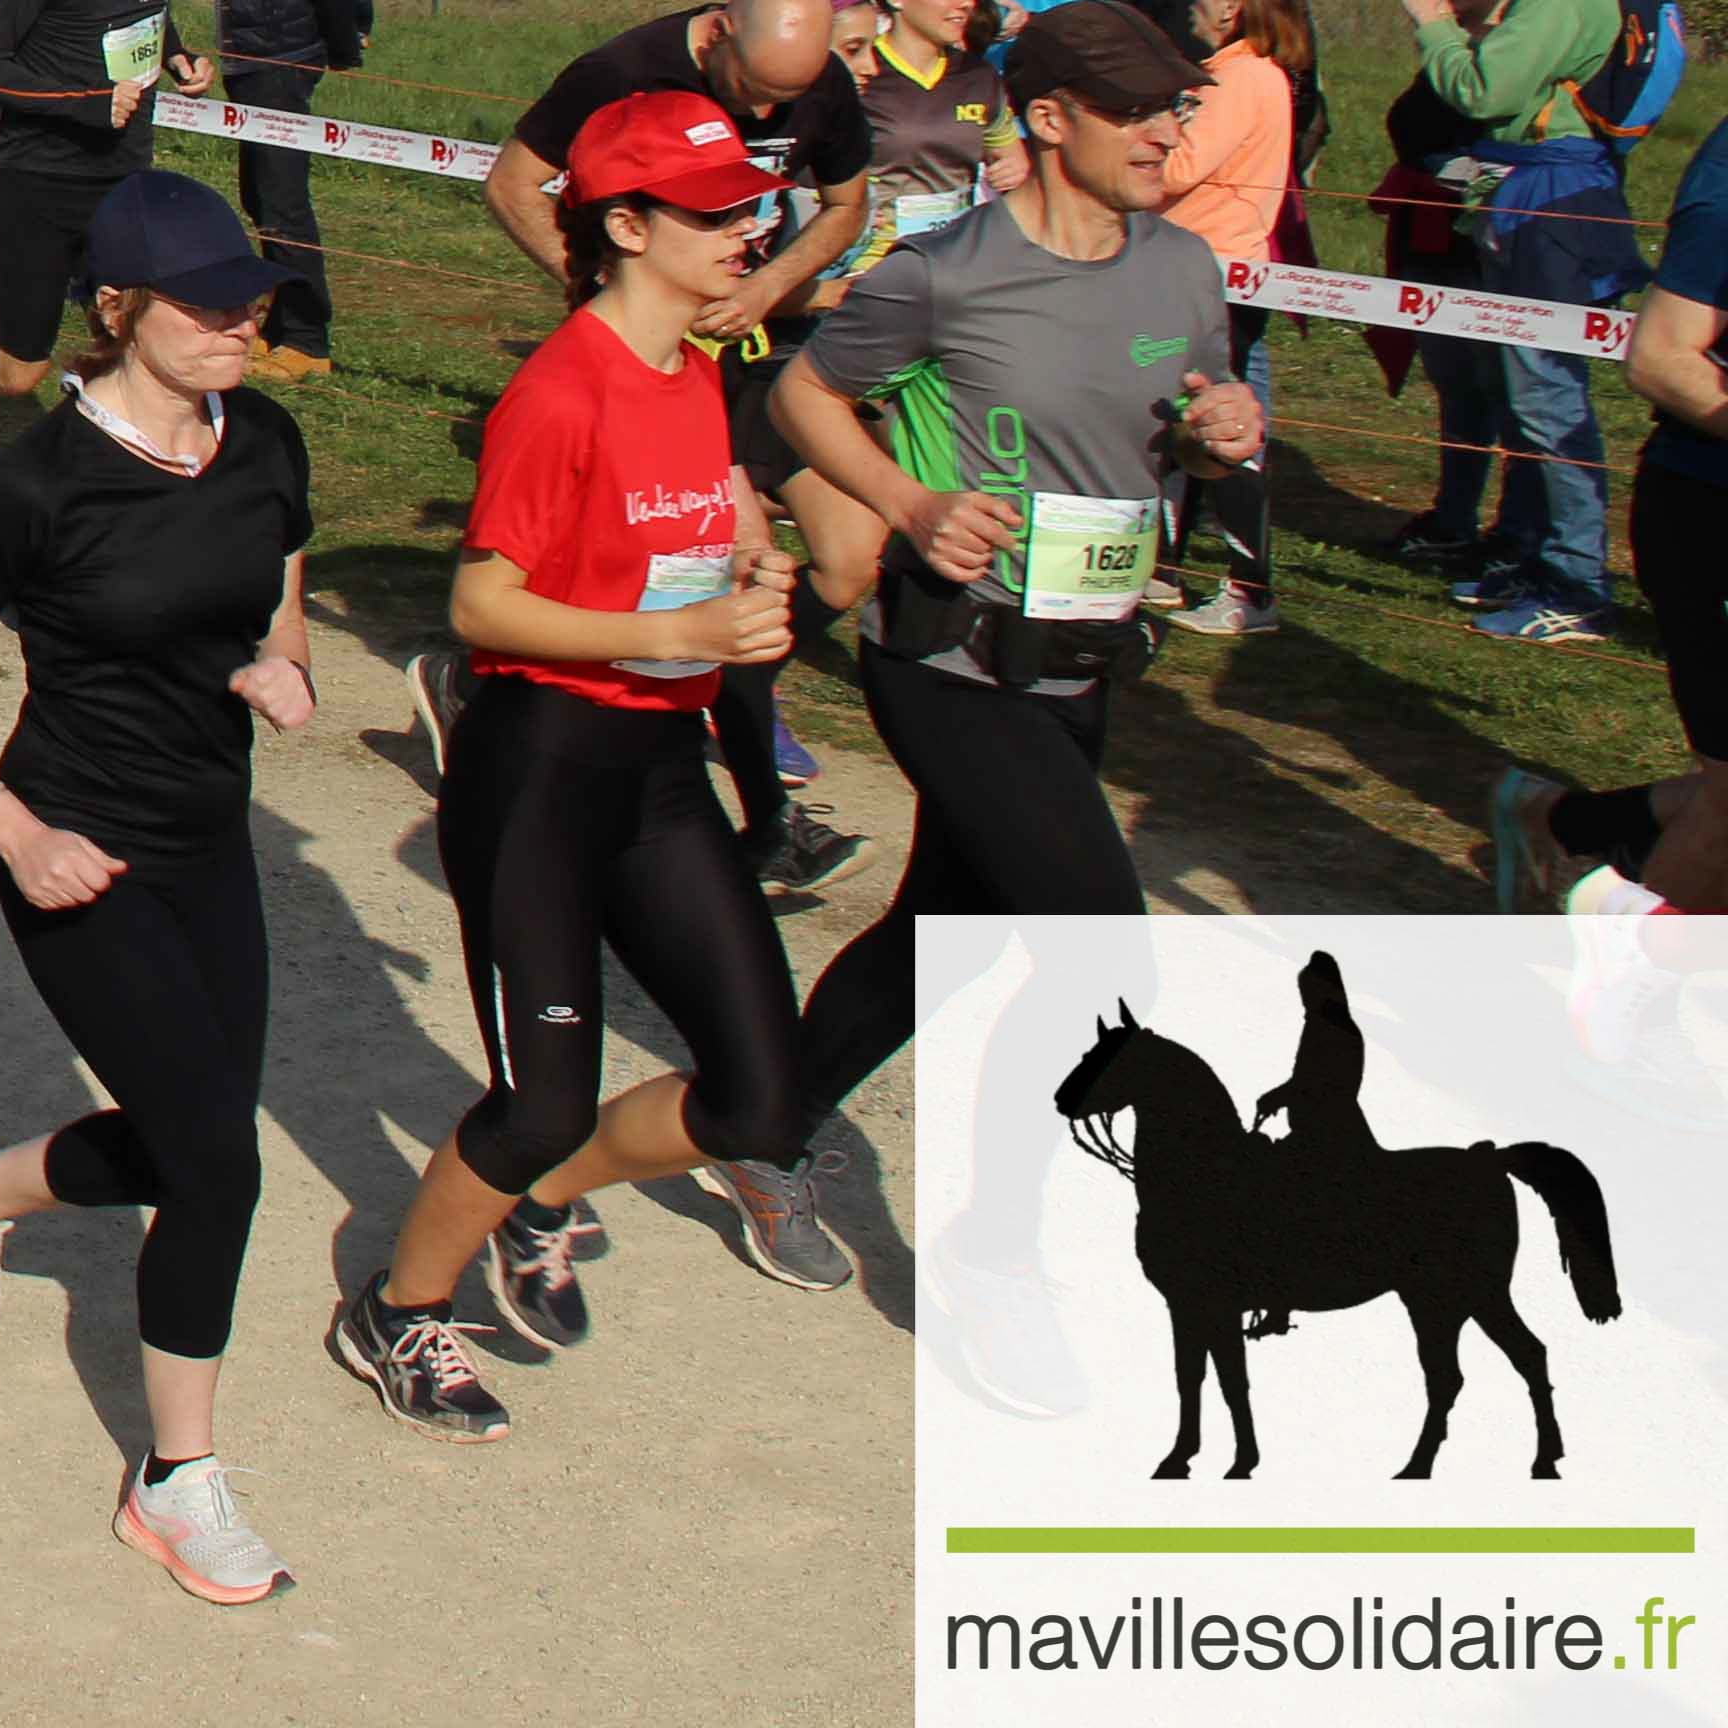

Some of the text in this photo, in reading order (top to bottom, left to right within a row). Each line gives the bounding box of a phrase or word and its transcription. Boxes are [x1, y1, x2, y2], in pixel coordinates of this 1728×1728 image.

[224, 105, 249, 134] Ry
[325, 121, 350, 152] Ry
[431, 139, 459, 171] Ry
[1227, 261, 1269, 300] Ry
[1399, 286, 1444, 326] Ry
[1584, 311, 1633, 353] Ry
[1082, 543, 1137, 571] 1628
[1079, 575, 1132, 589] PHILIPPE
